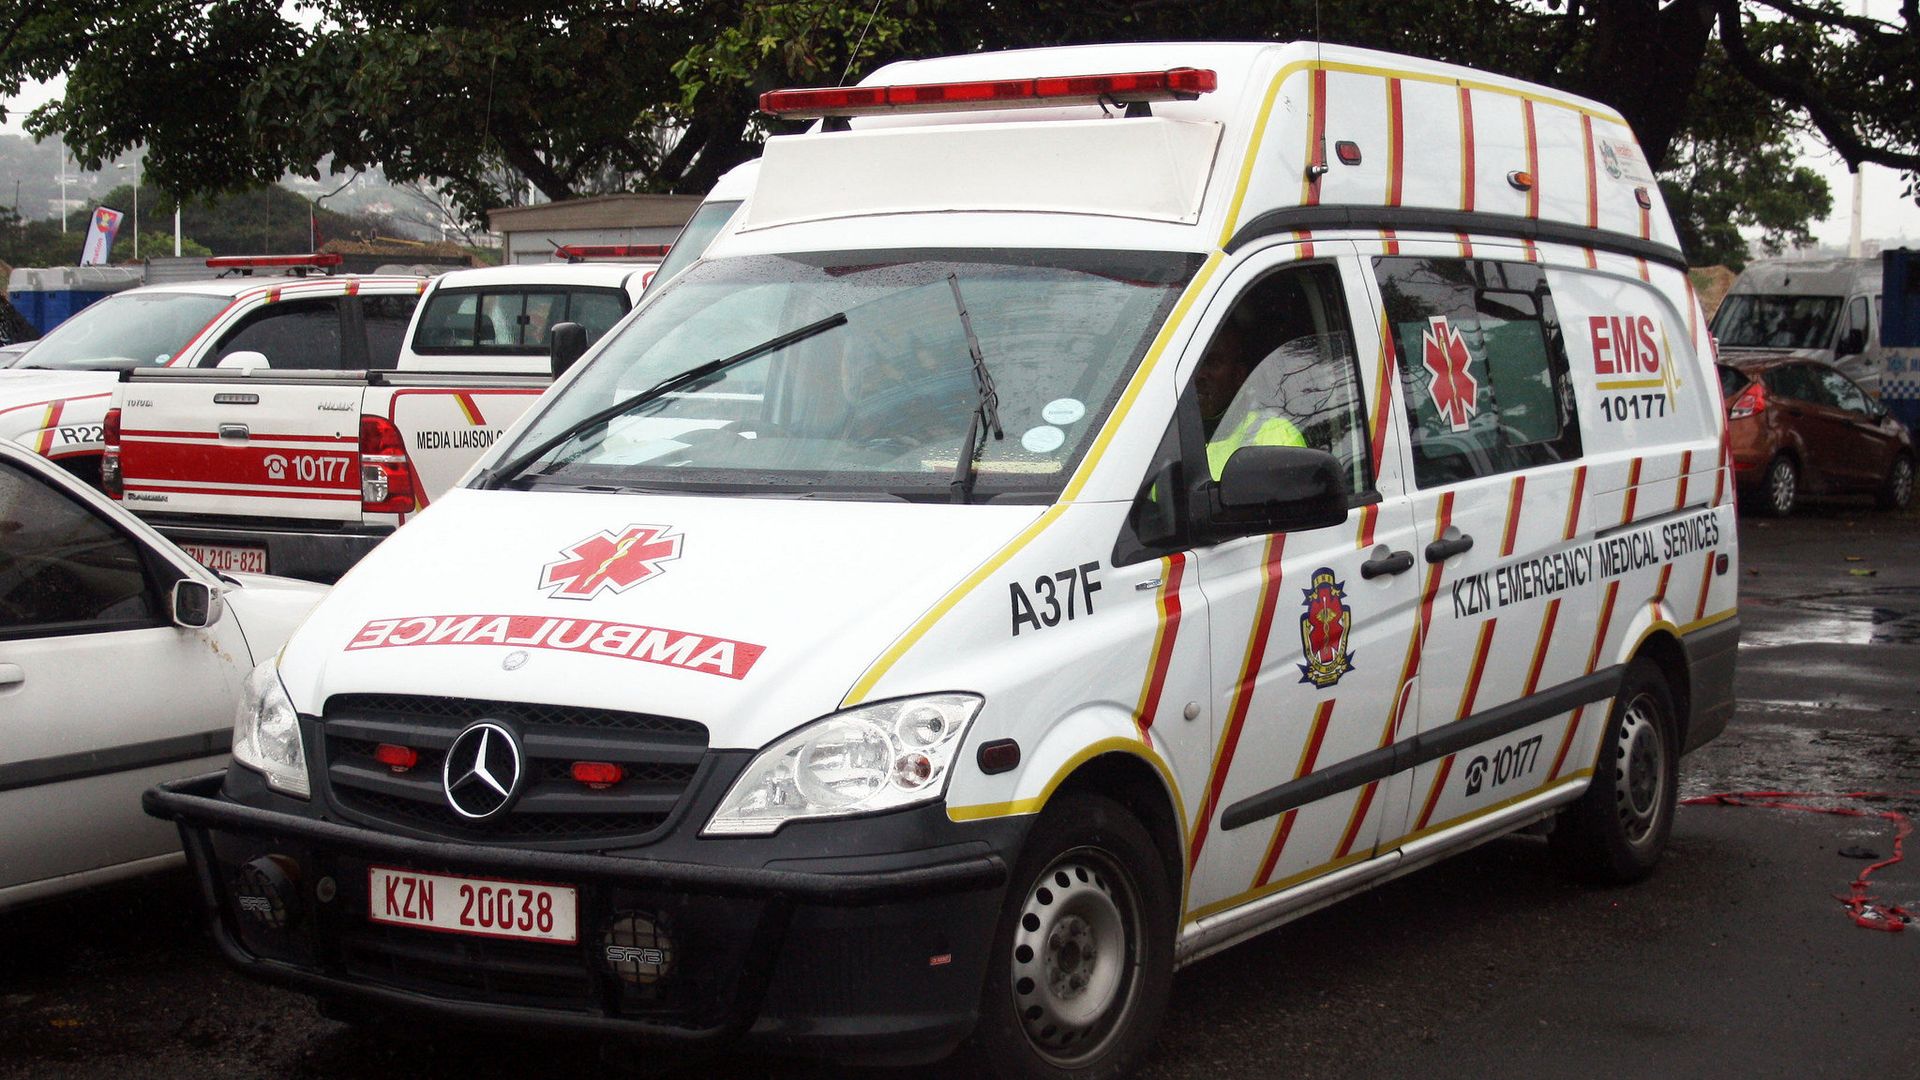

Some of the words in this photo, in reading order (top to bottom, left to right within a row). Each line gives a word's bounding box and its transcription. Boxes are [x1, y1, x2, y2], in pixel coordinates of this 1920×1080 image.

[1588, 315, 1659, 375] EMS
[1600, 392, 1666, 423] 10177
[417, 430, 451, 449] MEDIA
[453, 429, 494, 449] LIAISON
[292, 455, 351, 483] 10177
[209, 549, 263, 573] 210-821
[1452, 577, 1491, 619] KZN
[1498, 549, 1596, 607] EMERGENCY
[1597, 531, 1659, 579] MEDICAL
[1662, 512, 1719, 561] SERVICES
[1009, 560, 1102, 637] A37F
[1491, 735, 1543, 788] 10177
[385, 875, 434, 922] KZN
[460, 884, 554, 934] 20038
[606, 945, 664, 966] SRB
